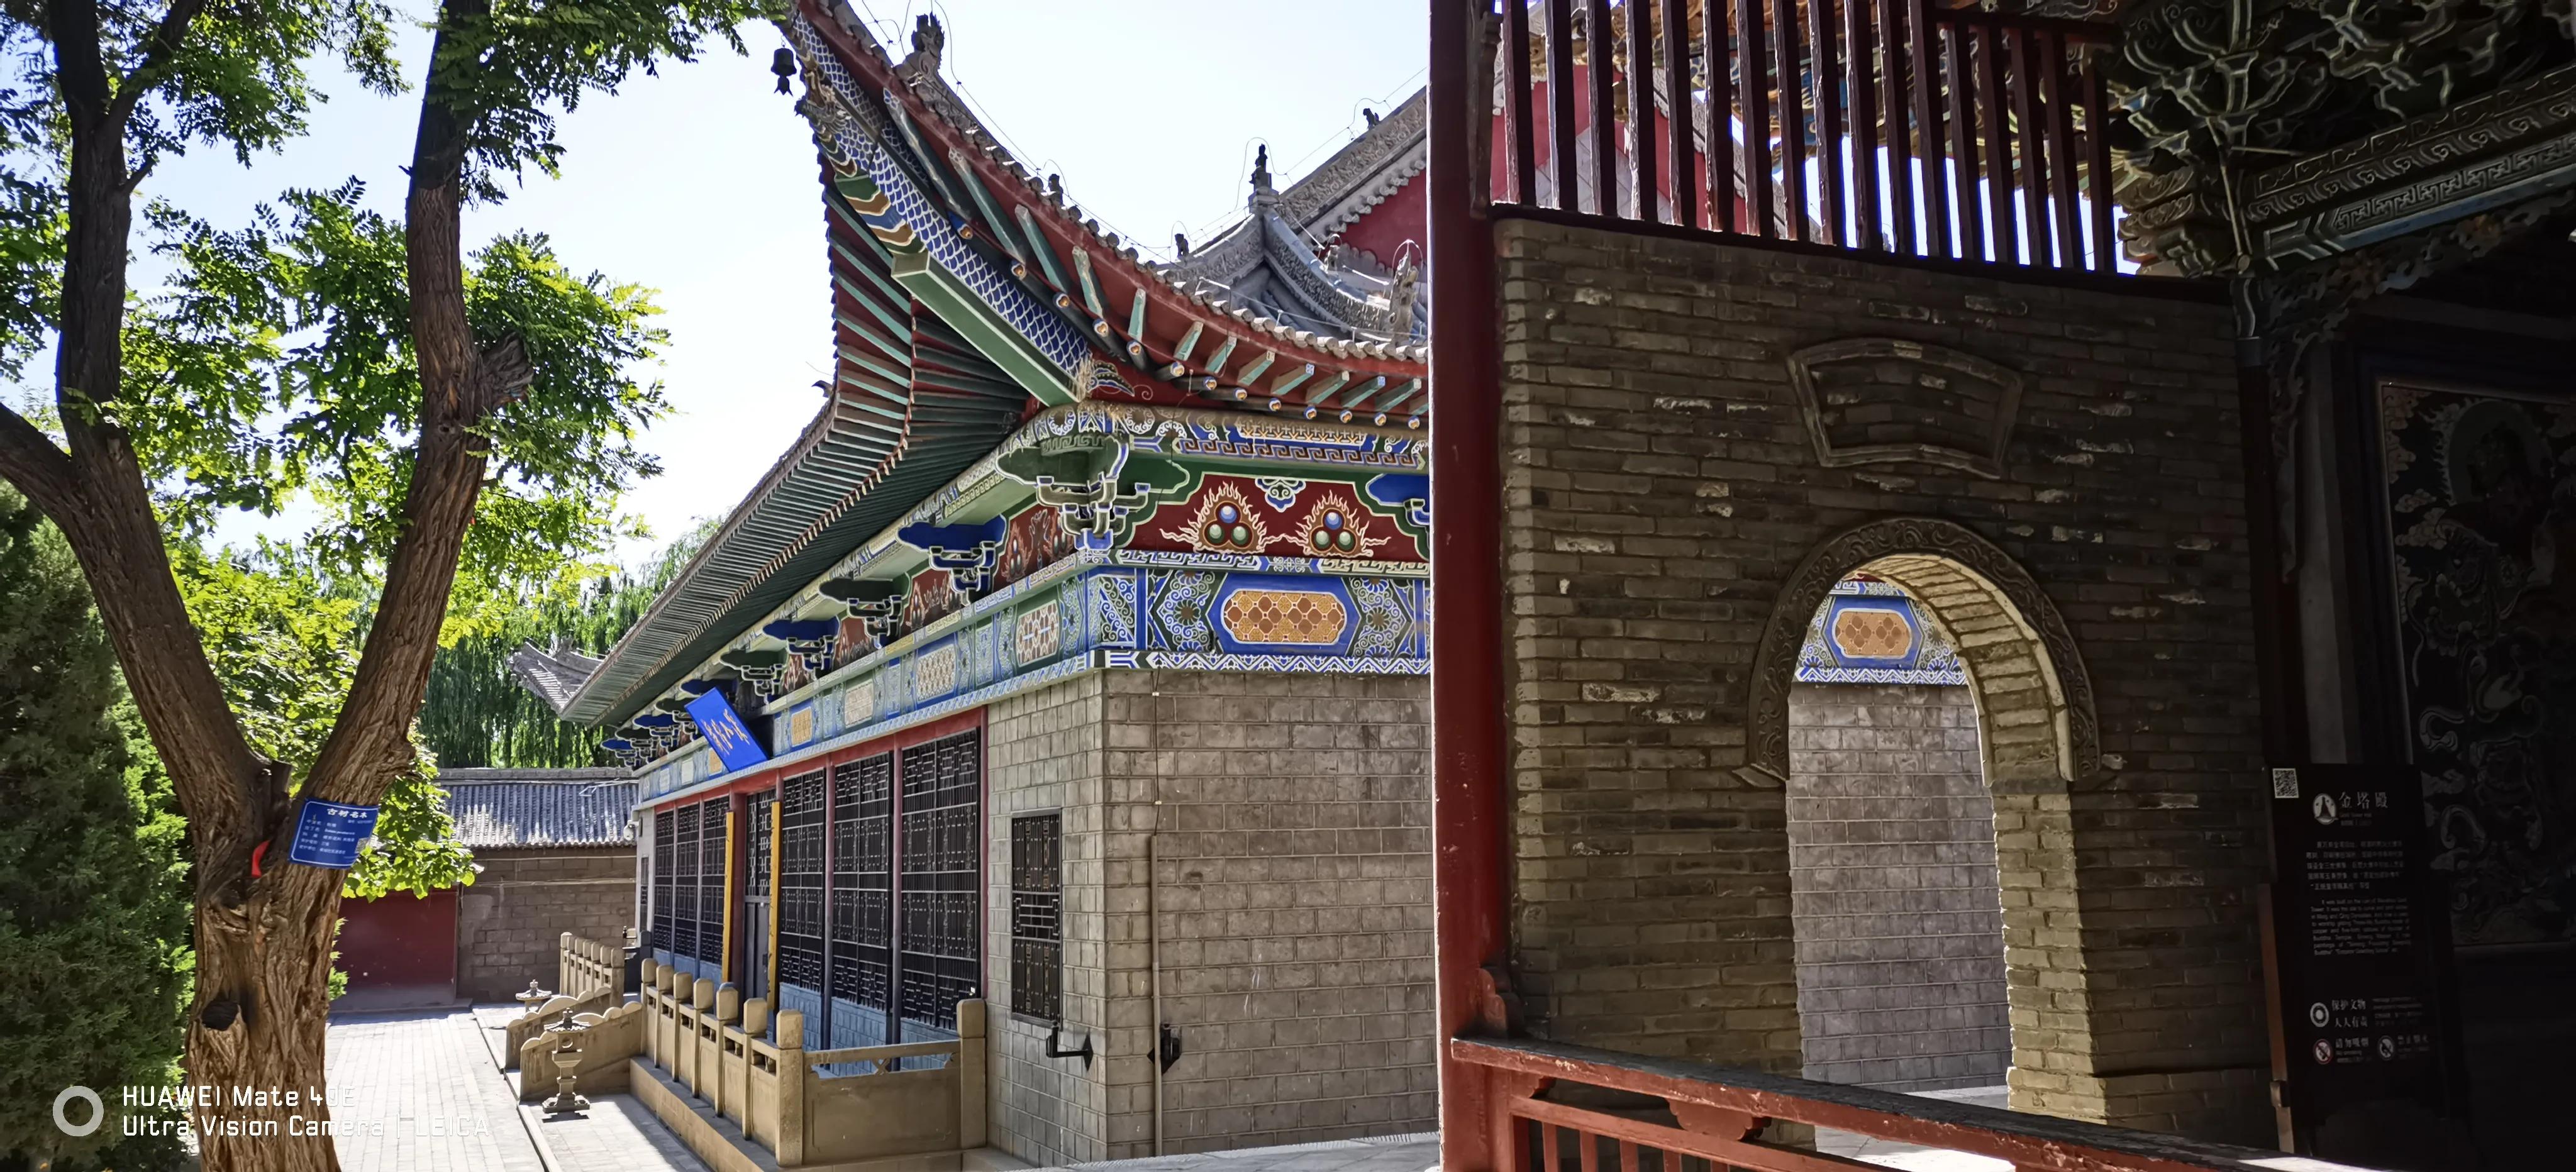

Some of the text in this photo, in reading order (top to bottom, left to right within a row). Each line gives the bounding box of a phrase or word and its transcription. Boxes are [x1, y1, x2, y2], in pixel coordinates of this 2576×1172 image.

[2338, 791, 2388, 809] 金塔殿
[327, 808, 367, 818] 古树名木
[2332, 998, 2366, 1011] 保护文物
[2334, 1016, 2368, 1028] 人人有责
